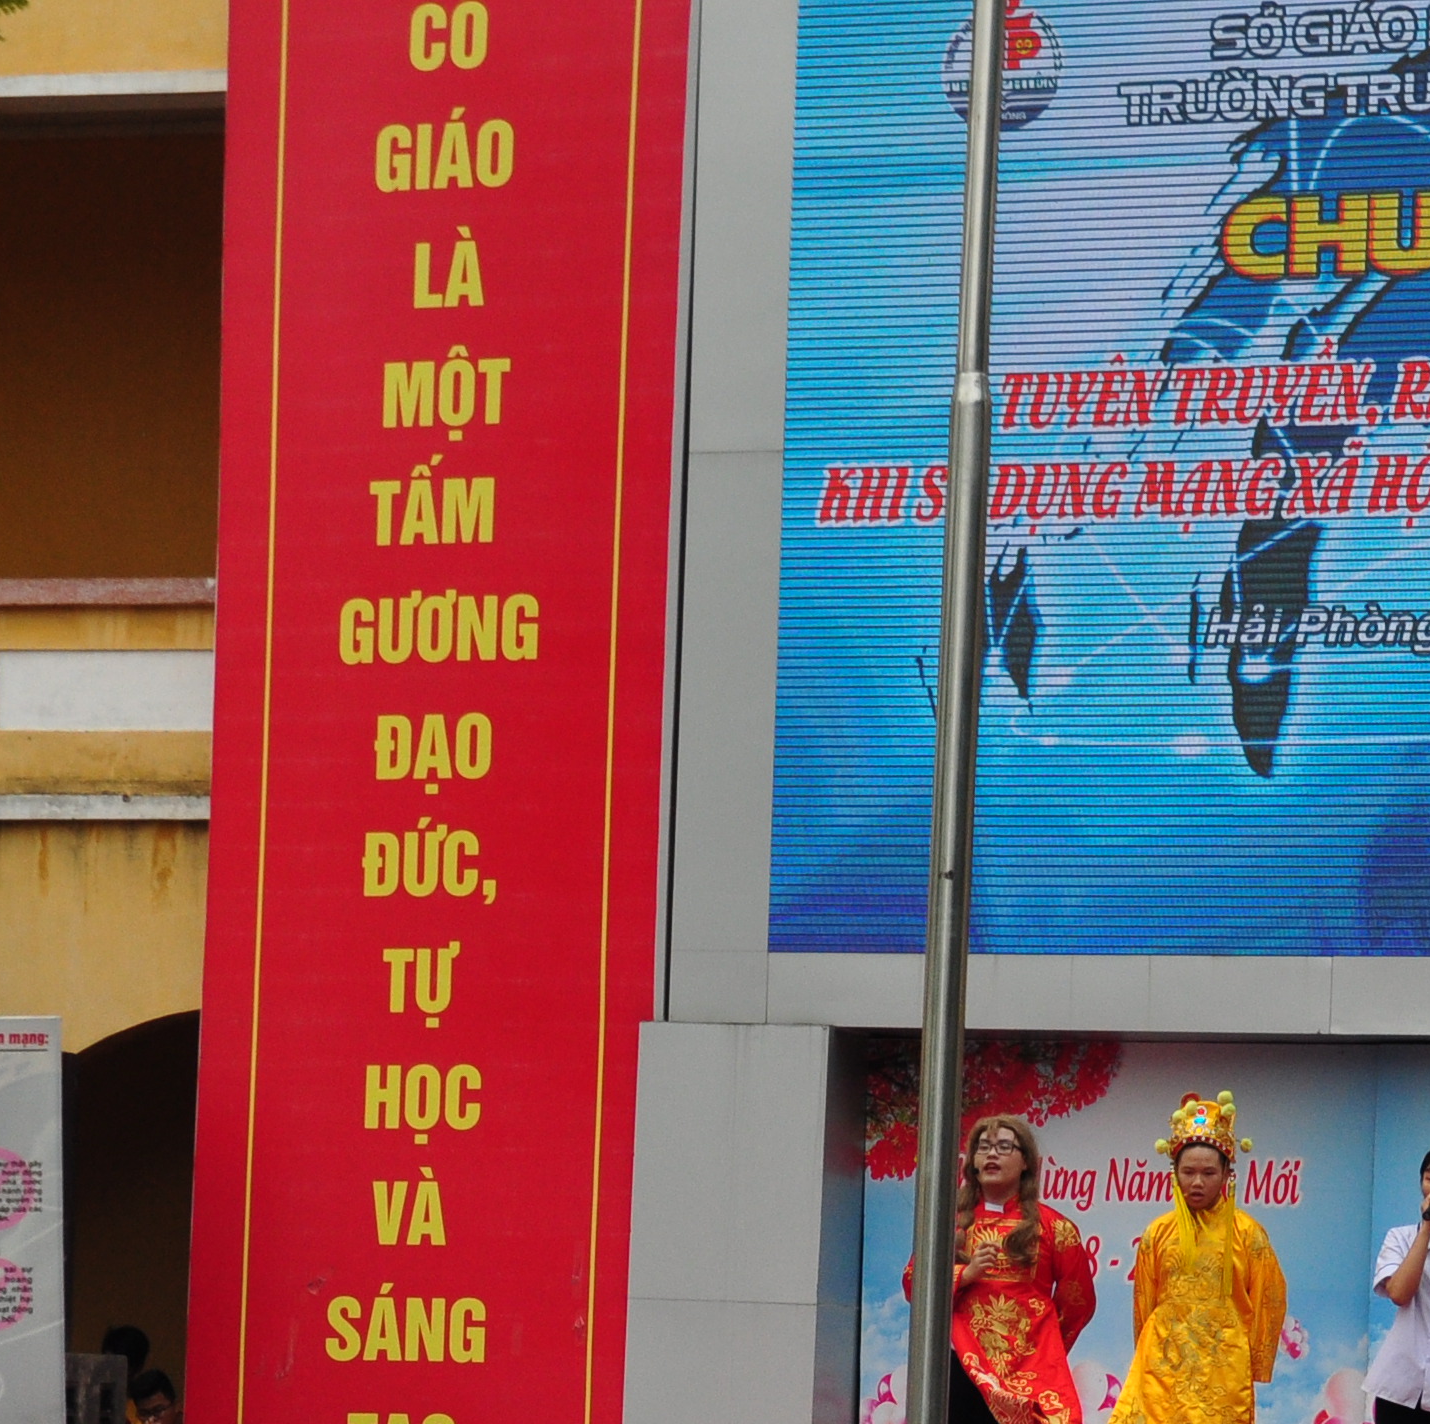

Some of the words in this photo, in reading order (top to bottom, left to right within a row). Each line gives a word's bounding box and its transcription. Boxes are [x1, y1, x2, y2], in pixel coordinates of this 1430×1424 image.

[1295, 1, 1417, 54] GIÁO
[1119, 68, 1326, 126] TRƯỜNG
[375, 107, 514, 192] GIÁO
[413, 226, 484, 309] LÀ
[382, 345, 512, 442] MỘT
[998, 352, 1165, 431] TUYÊN
[1170, 336, 1383, 428] TRUYỀN,
[369, 455, 497, 547] TẤM
[817, 462, 913, 526] KHI
[988, 461, 1129, 536] DỤNG
[1133, 457, 1285, 534] MẠNG
[1283, 438, 1367, 518] XÃ
[339, 588, 540, 665] GƯƠNG
[1205, 603, 1283, 646] Hải
[374, 712, 493, 794] ĐẠO
[362, 817, 498, 905] ĐỨC,
[382, 941, 461, 1028] TỰ
[8, 1031, 49, 1048] mạng:
[364, 1063, 483, 1145] HỌC
[372, 1166, 447, 1247] VÀ
[1037, 1159, 1097, 1211] ừng
[1105, 1157, 1173, 1203] Năm
[1244, 1160, 1301, 1206] Mới
[325, 1283, 486, 1363] SÁNG
